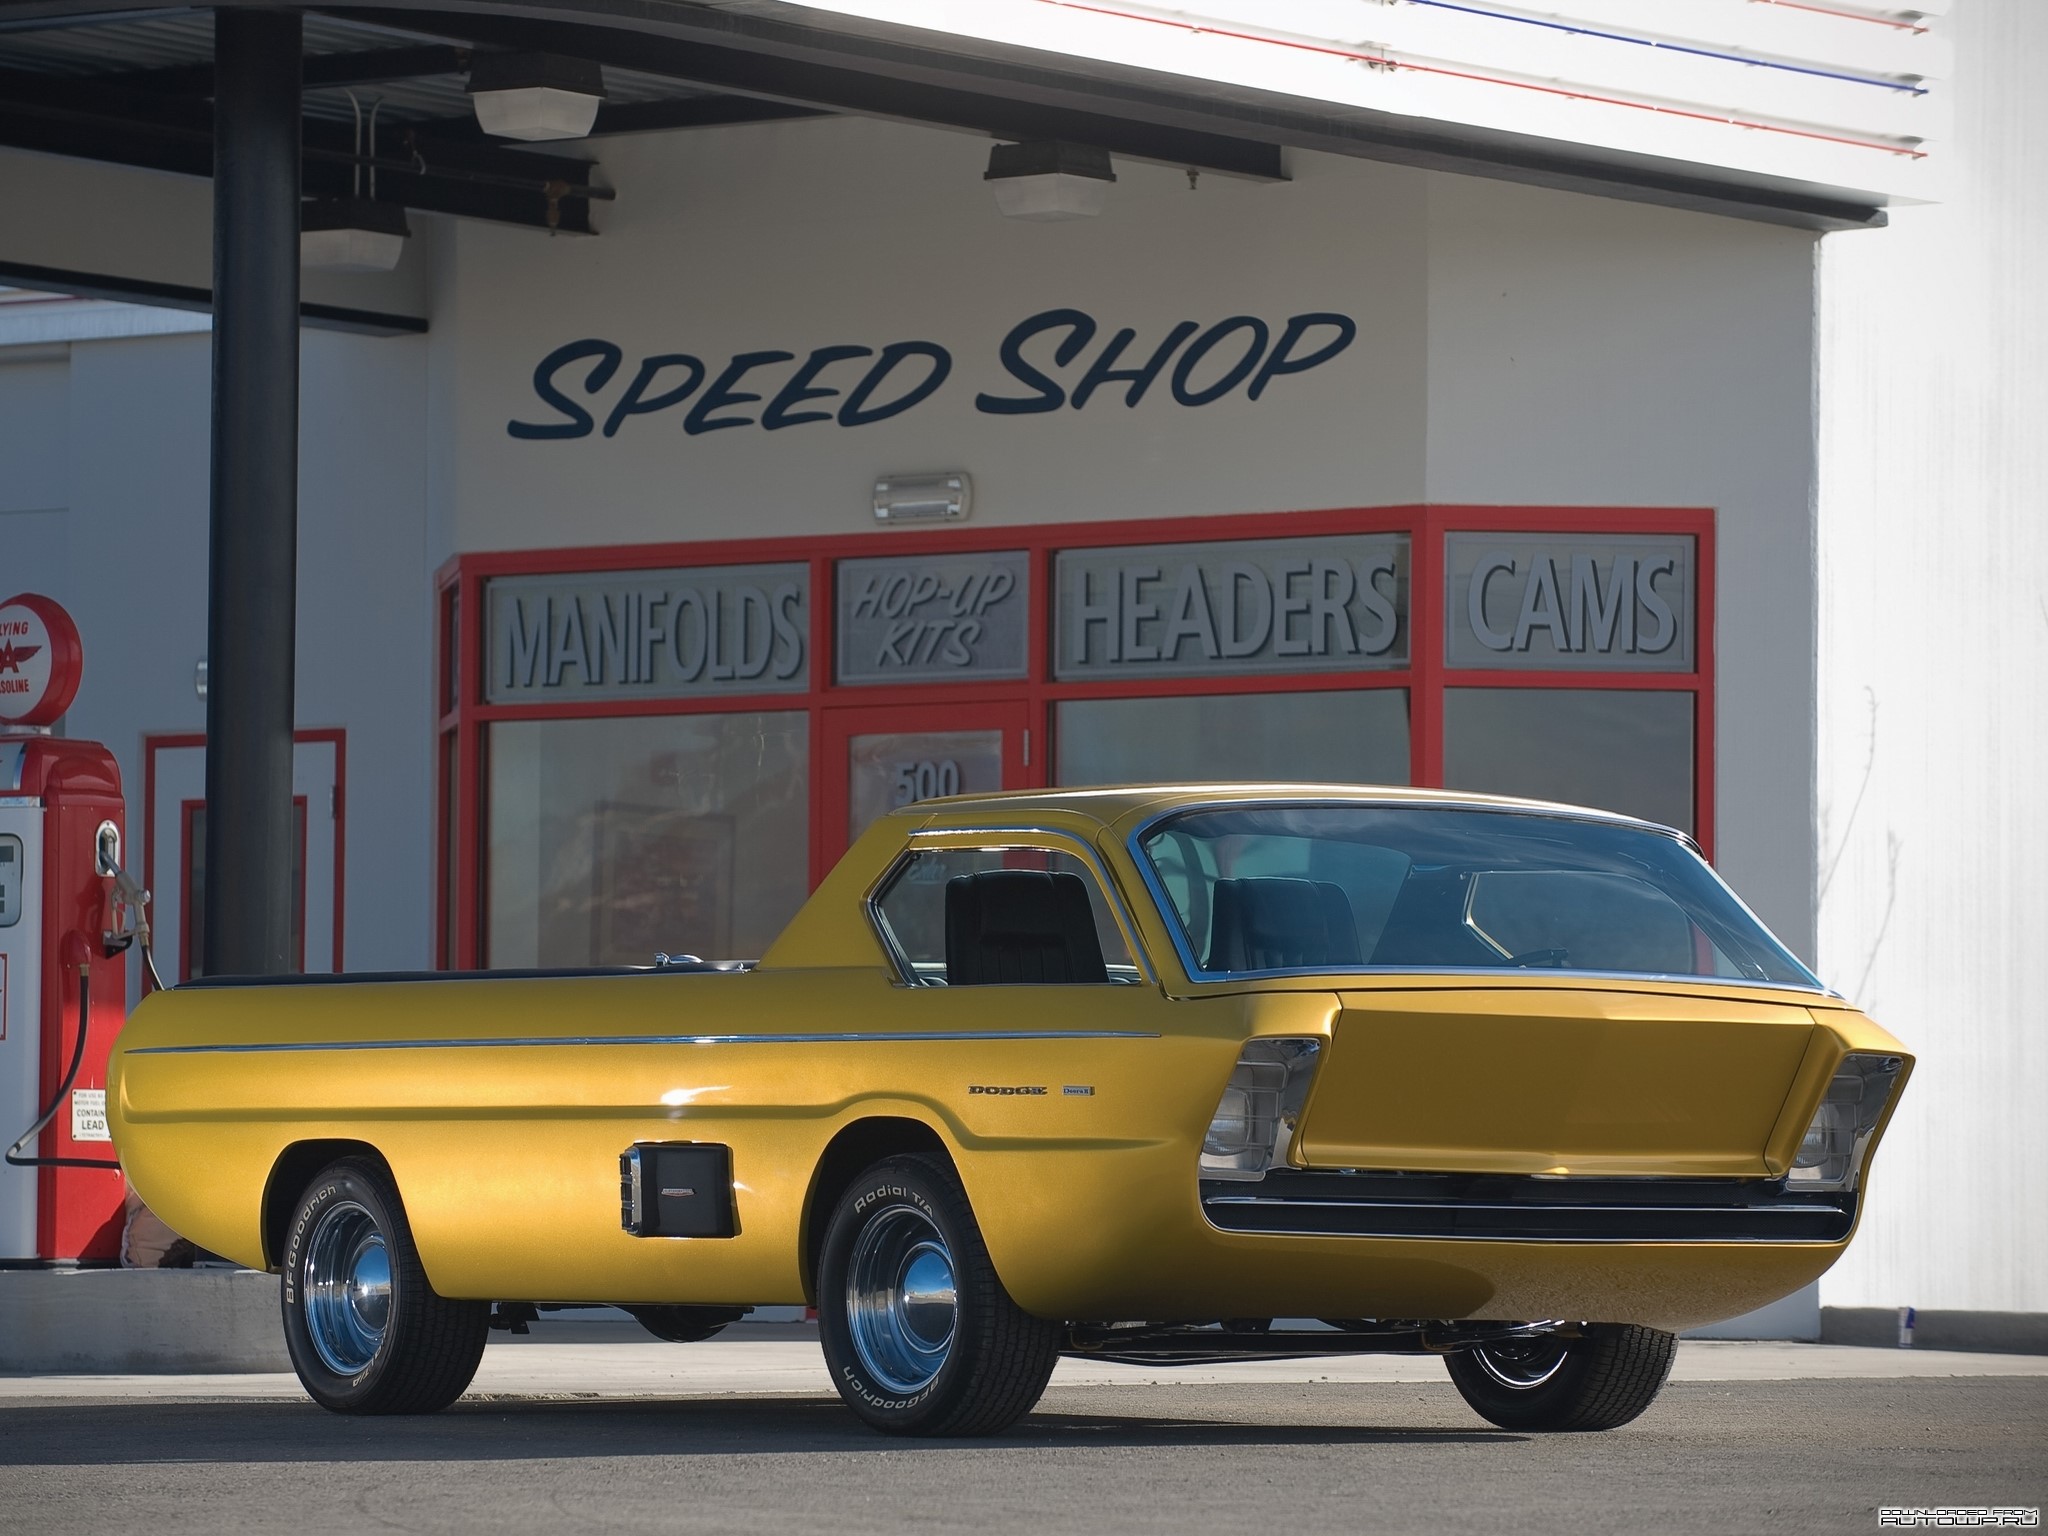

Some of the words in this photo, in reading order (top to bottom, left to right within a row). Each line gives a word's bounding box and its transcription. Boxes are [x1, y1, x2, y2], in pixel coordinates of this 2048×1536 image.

[507, 338, 953, 440] SPEED
[975, 308, 1357, 414] SHOP
[853, 566, 1016, 619] HOP-UP
[1073, 551, 1398, 664] HEADERS
[1467, 550, 1679, 654] CAMS
[0, 622, 29, 636] LYING
[504, 582, 805, 688] MANIFOLDS
[876, 618, 987, 668] KITS
[0, 679, 30, 694] SOLINE
[895, 759, 966, 806] 500
[76, 1109, 105, 1117] CONTAIN
[968, 1085, 1048, 1096] DODGE
[81, 1120, 105, 1130] LEAD
[853, 1184, 907, 1214] Radial
[286, 1184, 337, 1304] BFGoodrich
[843, 1365, 939, 1410] BFGoodrich
